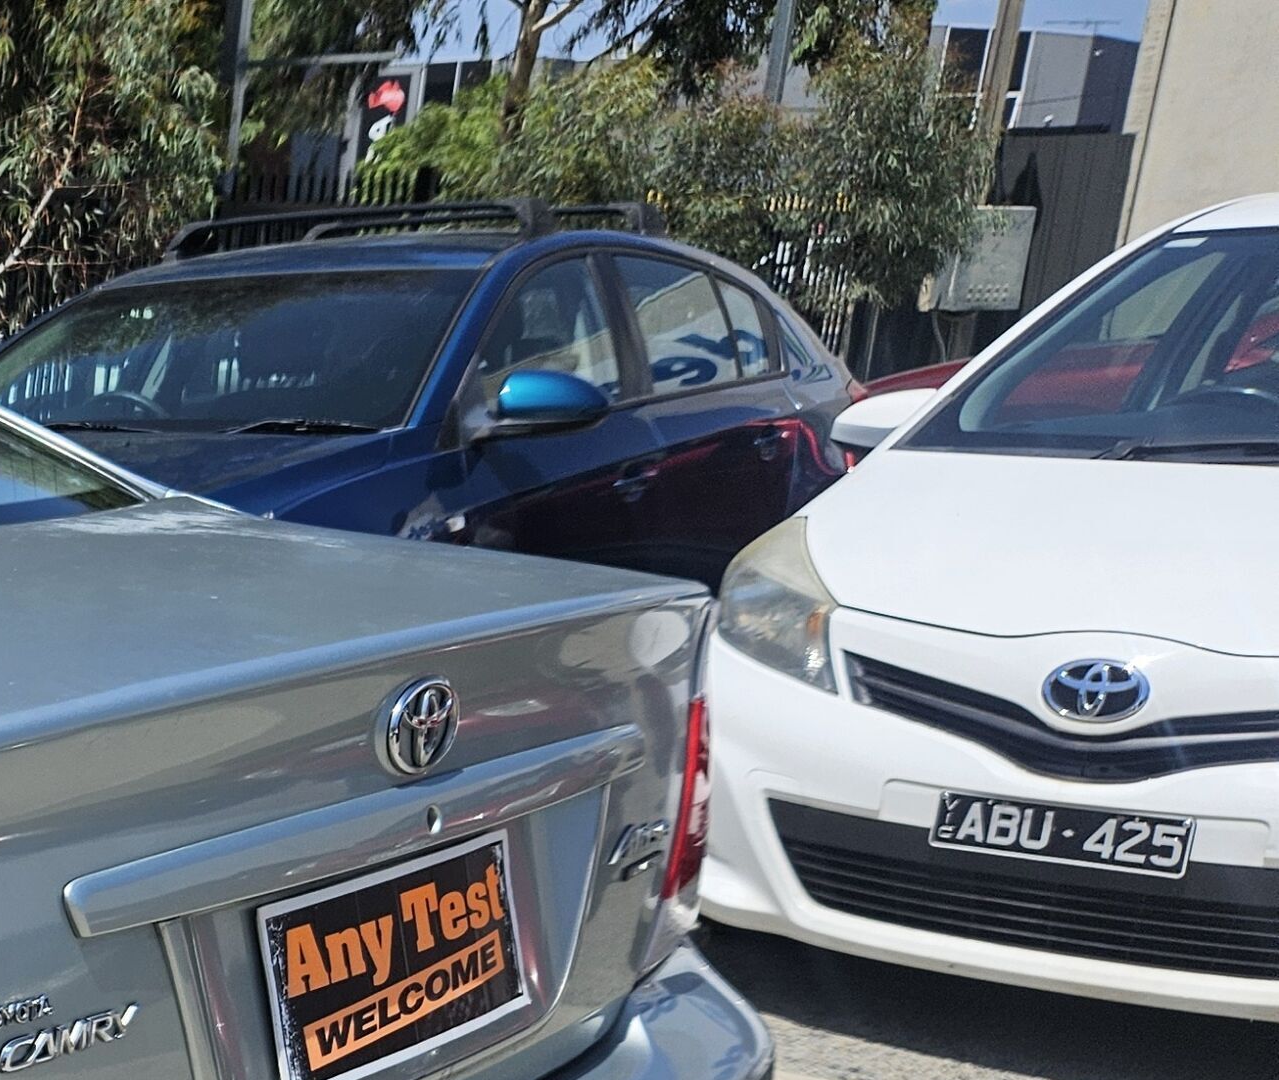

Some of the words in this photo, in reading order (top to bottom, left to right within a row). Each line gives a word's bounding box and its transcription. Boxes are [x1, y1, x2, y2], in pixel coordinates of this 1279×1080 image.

[955, 801, 1055, 851] ABU
[1082, 817, 1188, 868] 425
[286, 922, 394, 999] Any
[399, 862, 506, 954] Test
[314, 940, 498, 1057] WELCOME
